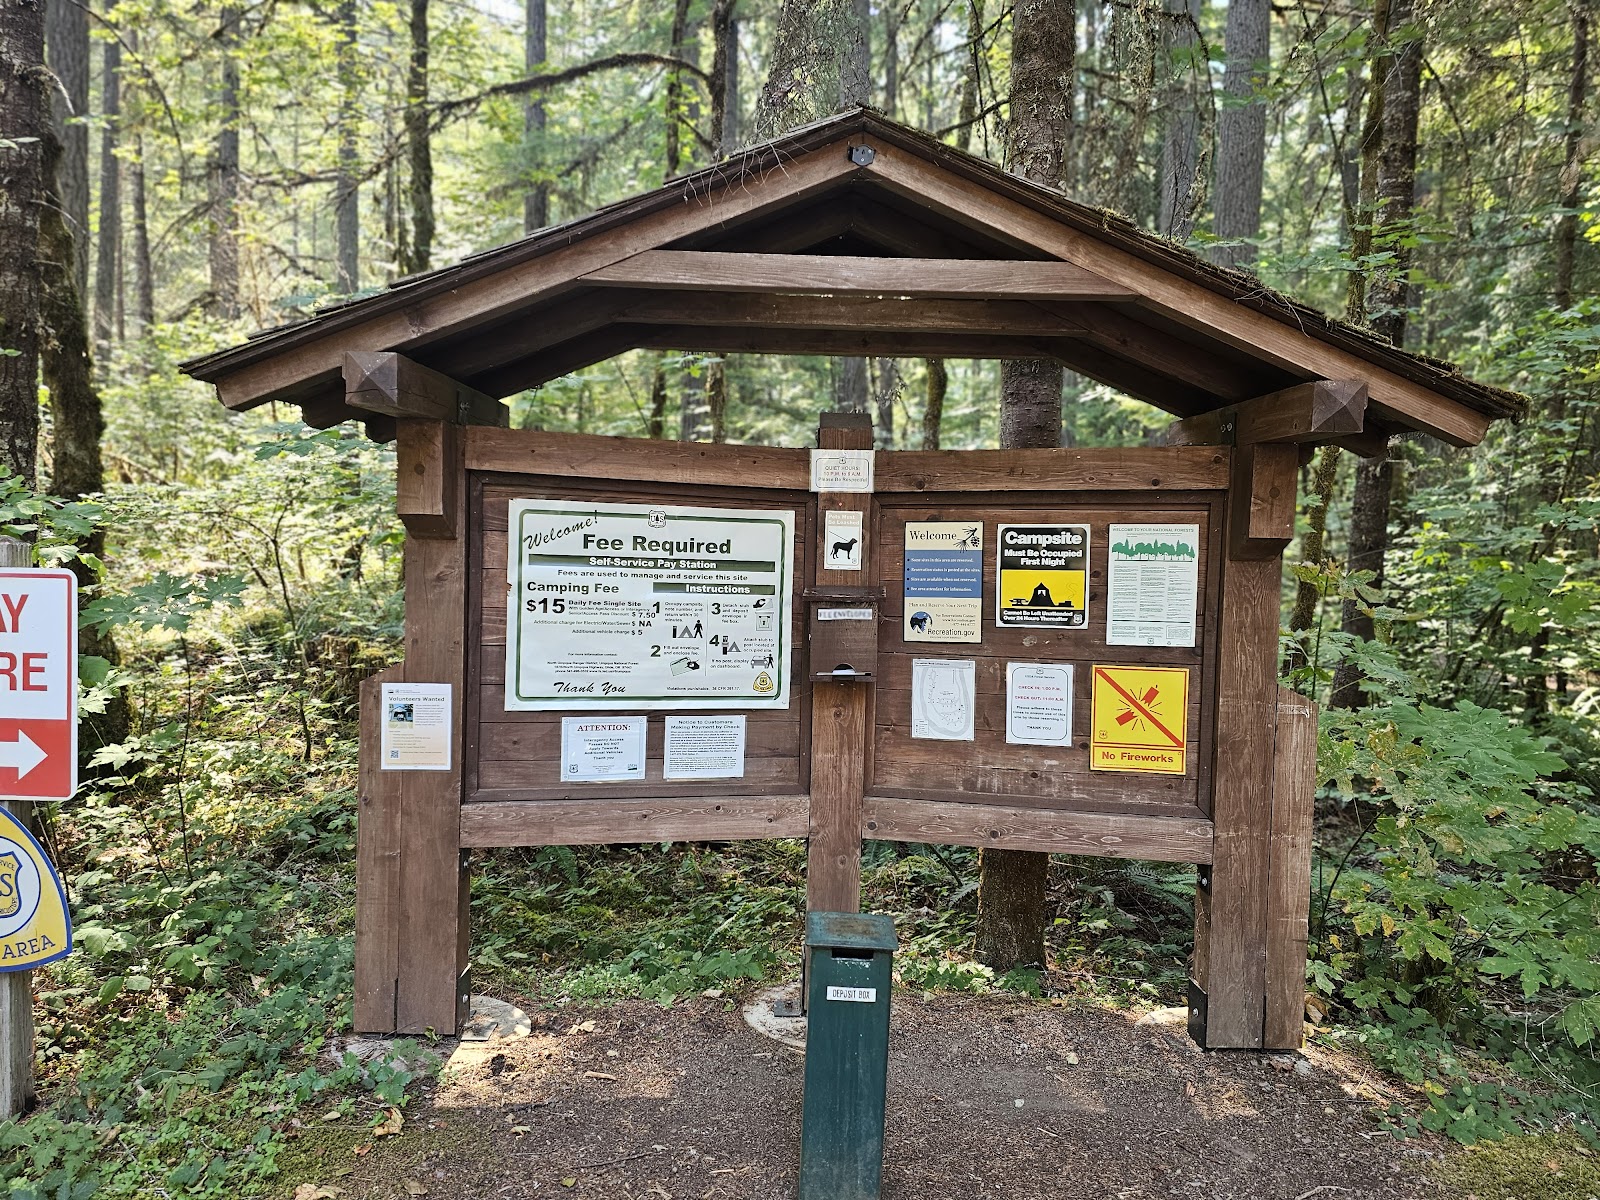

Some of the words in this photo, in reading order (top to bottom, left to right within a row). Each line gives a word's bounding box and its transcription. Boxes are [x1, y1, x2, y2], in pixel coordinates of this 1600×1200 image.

[523, 509, 598, 549] Welcome!
[910, 531, 957, 540] Welcome
[1005, 531, 1082, 547] Campsite
[583, 533, 624, 551] Fee
[632, 535, 731, 556] Required
[1040, 550, 1082, 558] Occupied
[589, 557, 655, 568] Self-Service
[657, 559, 676, 570] Pay
[679, 560, 716, 569] Station
[1041, 558, 1065, 567] Night
[558, 569, 577, 577] Fees
[596, 570, 616, 578] used
[715, 573, 731, 581] this
[527, 581, 591, 595] Camping
[594, 583, 620, 594] Fee
[685, 584, 750, 594] Instructions
[526, 597, 565, 614] $15
[652, 601, 660, 613] 1
[711, 603, 721, 615] 3
[927, 629, 975, 637] Recreation.gov
[709, 635, 719, 646] 4
[650, 645, 661, 657] 2
[553, 682, 595, 693] Thank
[601, 682, 626, 695] You
[577, 724, 631, 732] ATTENTION:
[1101, 751, 1116, 760] No
[1121, 752, 1174, 763] Fireworks
[2, 934, 56, 960] AREA
[832, 989, 856, 999] DEPOSIT
[859, 991, 870, 999] BOX
